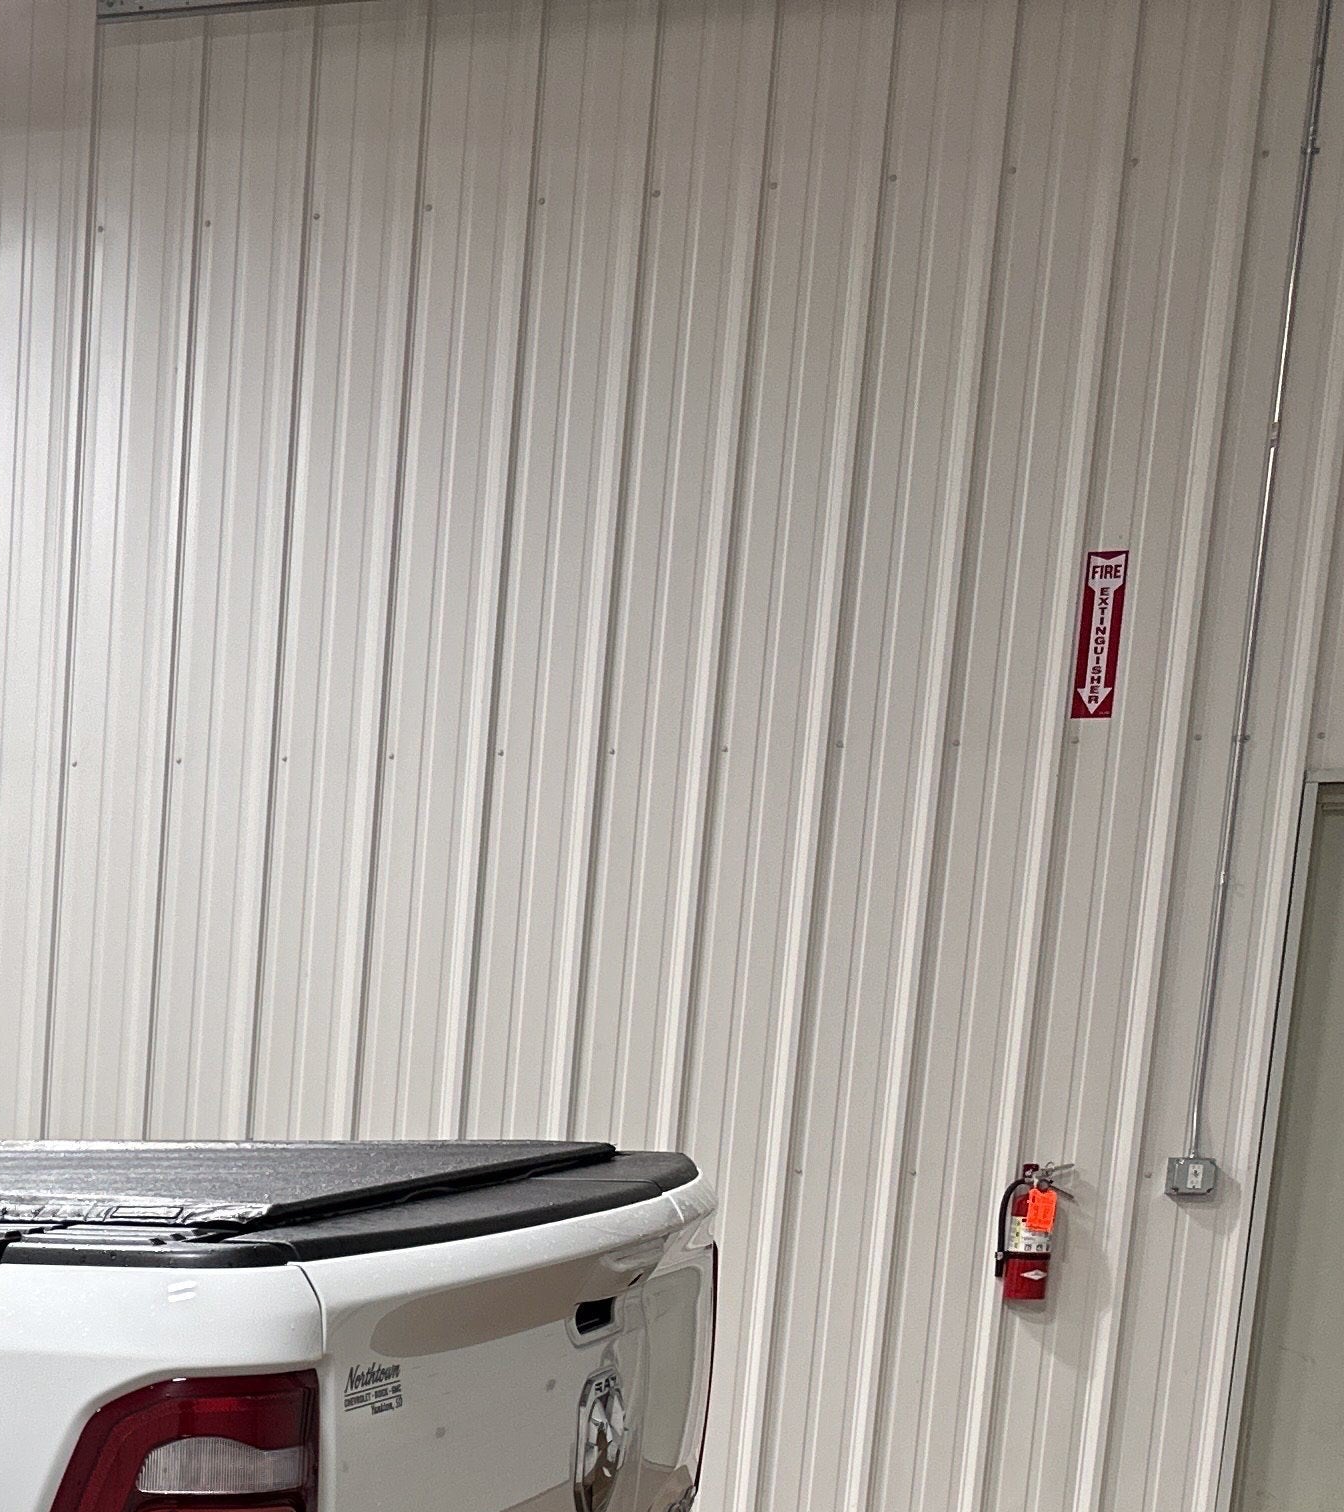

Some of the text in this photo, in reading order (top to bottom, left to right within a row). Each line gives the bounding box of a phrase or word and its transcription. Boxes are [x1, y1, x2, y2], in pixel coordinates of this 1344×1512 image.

[1092, 565, 1122, 579] FIRE
[1088, 587, 1110, 704] EXTINGUISHER
[344, 1362, 401, 1393] Northtown
